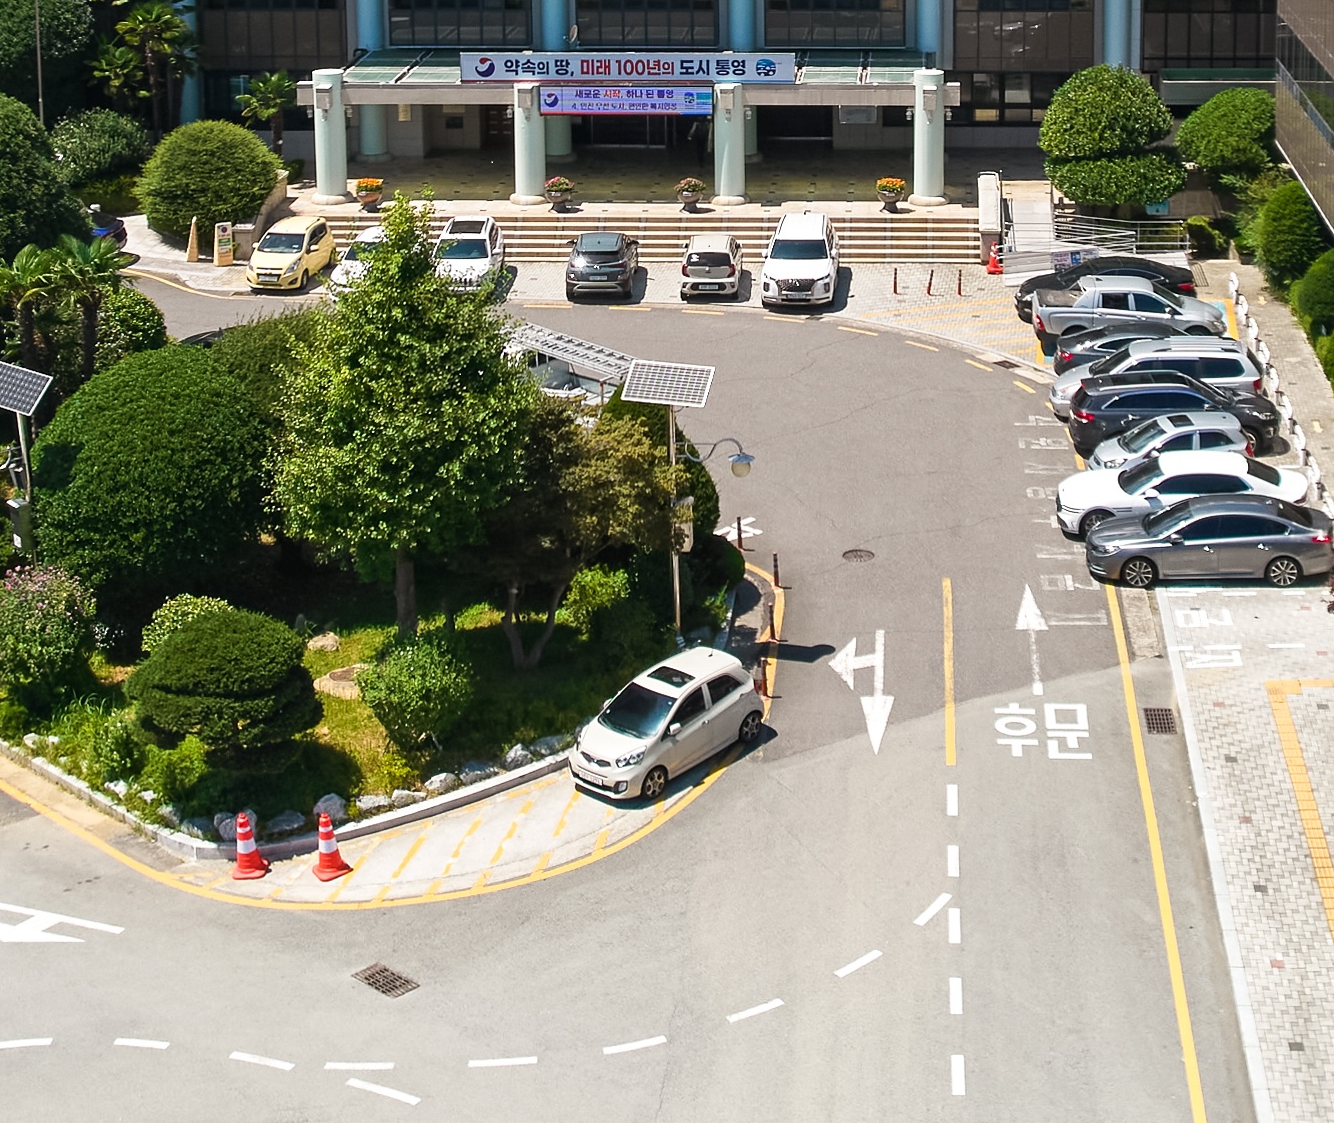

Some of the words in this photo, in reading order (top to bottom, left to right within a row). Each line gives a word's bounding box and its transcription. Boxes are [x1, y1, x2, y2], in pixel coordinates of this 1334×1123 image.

[503, 58, 551, 77] 약속의
[553, 58, 575, 78] 땅,
[579, 58, 612, 76] 미래
[614, 58, 676, 77] 100년의
[678, 58, 711, 76] 도시
[714, 58, 747, 77] 통영
[574, 89, 601, 99] 새로운
[626, 89, 643, 99] 하나
[993, 701, 1094, 761] 후문
